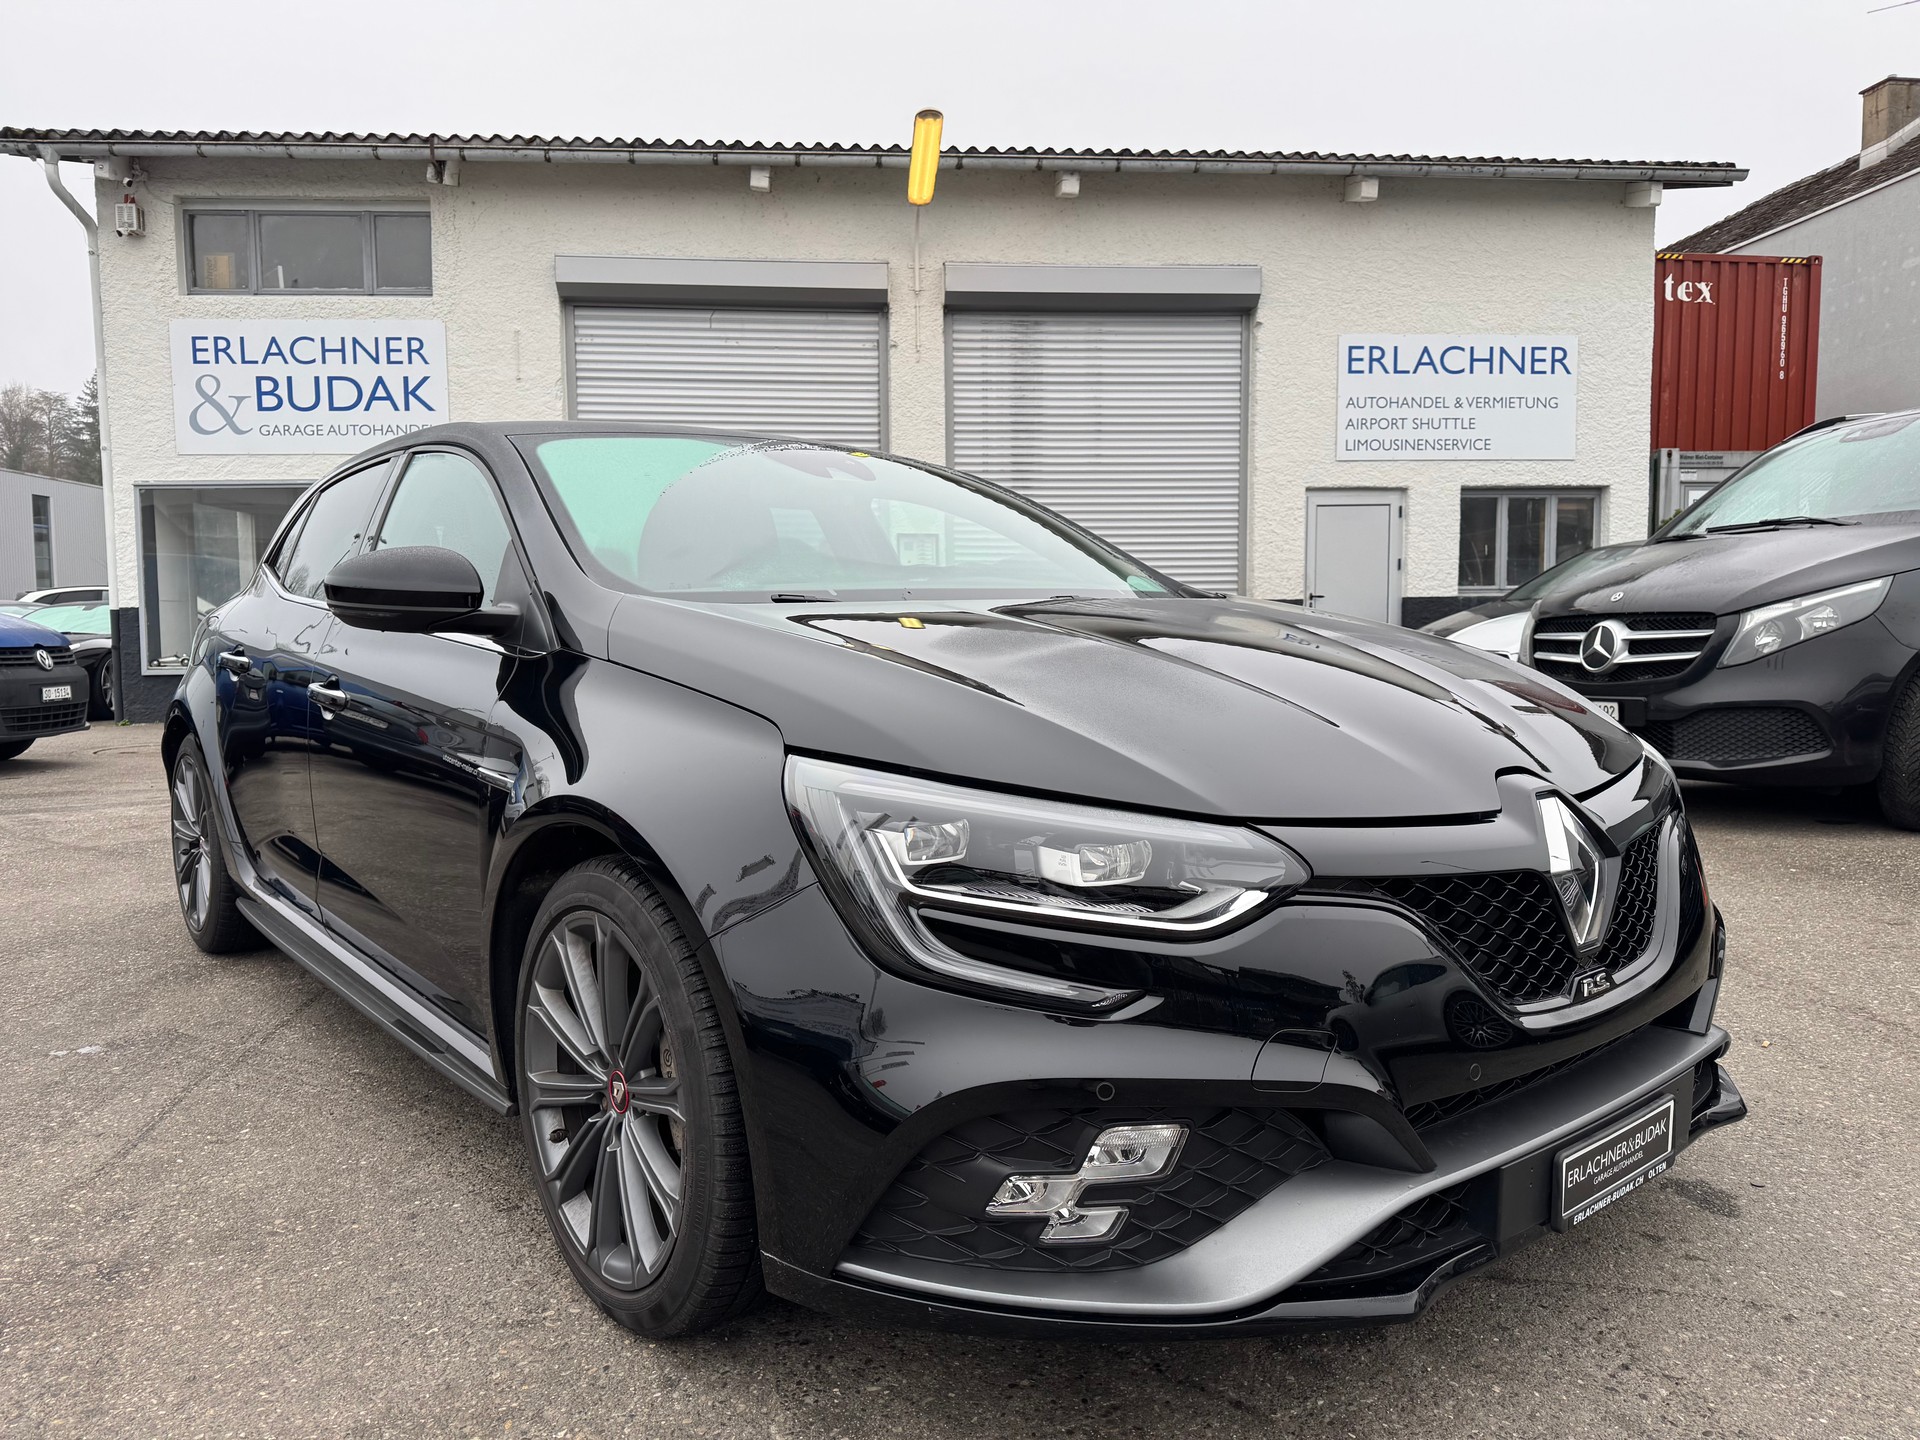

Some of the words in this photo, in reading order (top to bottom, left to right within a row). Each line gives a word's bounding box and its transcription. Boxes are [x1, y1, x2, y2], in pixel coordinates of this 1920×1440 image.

[1663, 273, 1714, 304] tex
[190, 336, 430, 365] ERLACHNER
[1347, 345, 1572, 375] ERLACHNER
[188, 373, 253, 436] &
[255, 375, 435, 412] BUDAK
[1345, 396, 1450, 409] AUTOHANDEL
[1454, 396, 1464, 409] &
[1466, 396, 1559, 410] VERMIETUNG
[259, 423, 324, 437] GARAGE
[1345, 417, 1408, 430] AIRPORT
[1412, 417, 1476, 430] SHUTTLE
[1345, 438, 1492, 451] LIMOUSINENSERVICE
[1567, 1117, 1667, 1189] ERLACHNER&BUDAK
[1593, 1164, 1613, 1185] GARAGE
[1612, 1150, 1644, 1175] AUTOHANDEL
[1573, 1174, 1645, 1226] ERLACHNER-BUDAK.CH
[1648, 1161, 1667, 1179] OLTEN
